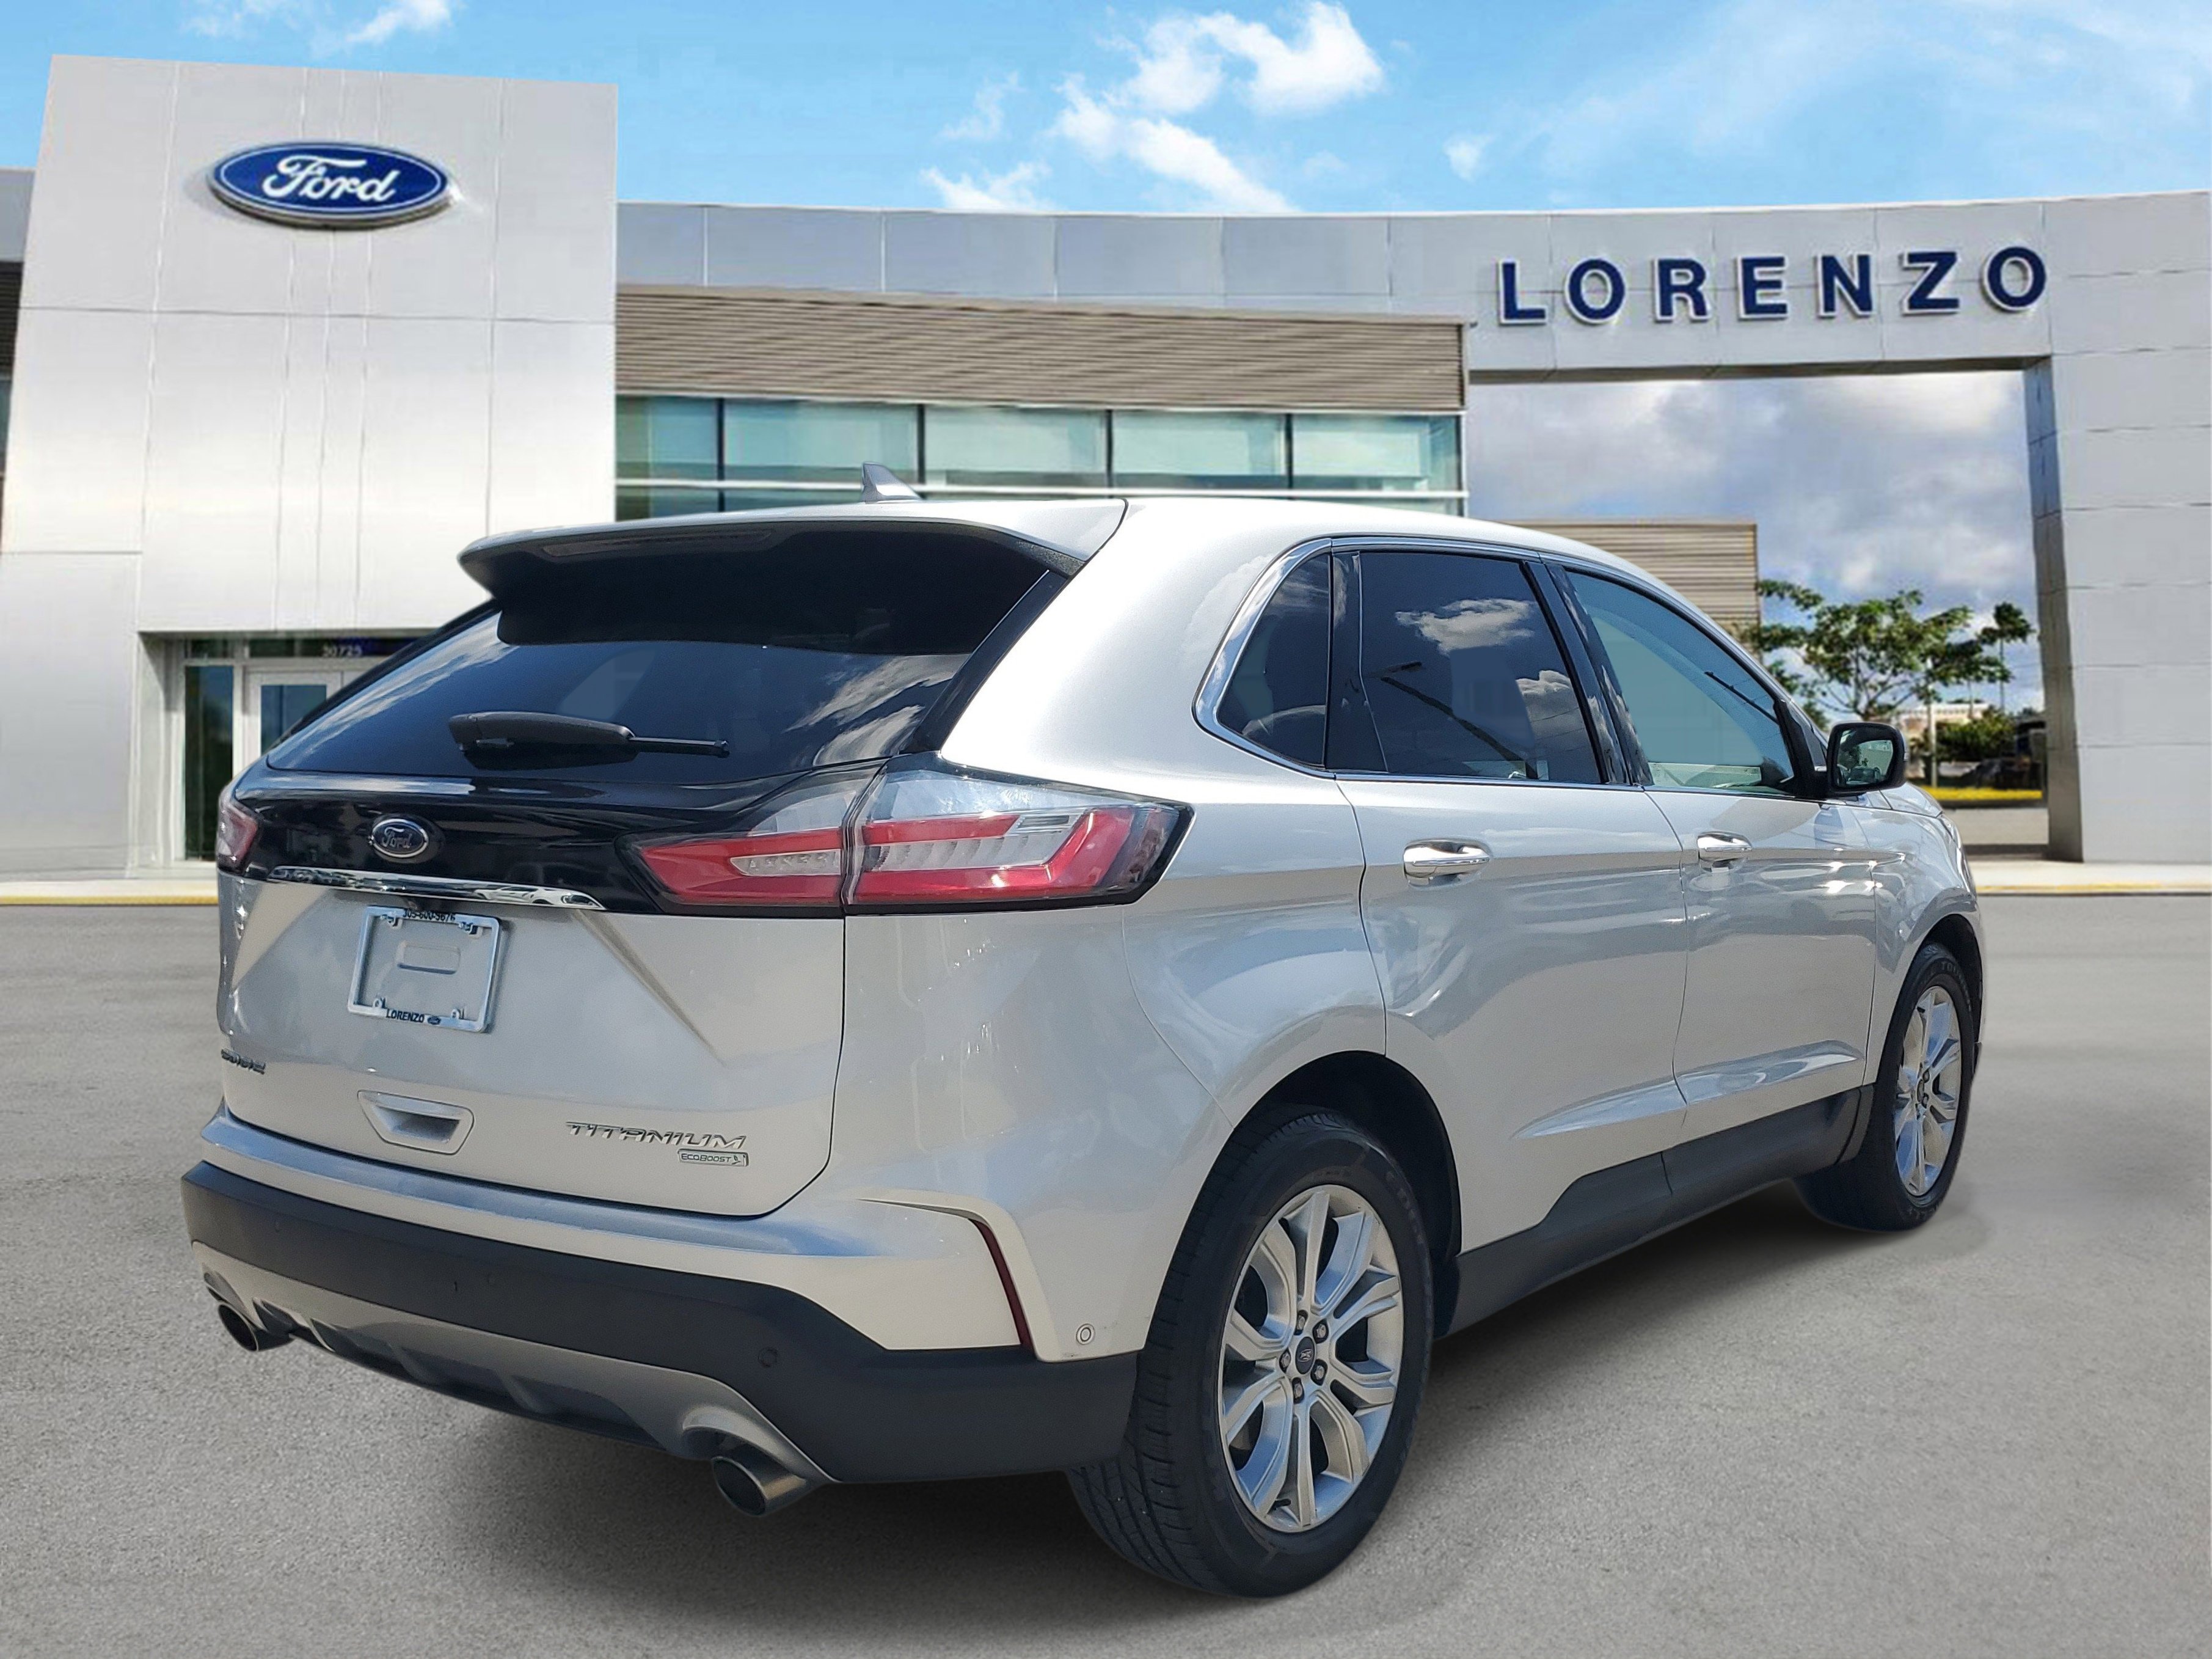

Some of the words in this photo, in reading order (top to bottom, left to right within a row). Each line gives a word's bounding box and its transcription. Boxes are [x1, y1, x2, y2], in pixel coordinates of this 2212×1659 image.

[262, 155, 401, 202] Ford
[1499, 247, 2048, 323] LORENZO
[382, 827, 412, 848] Ford
[386, 1009, 425, 1023] LORENZO
[566, 1122, 746, 1149] TITANIUM
[681, 1153, 731, 1162] ECOBOOST
